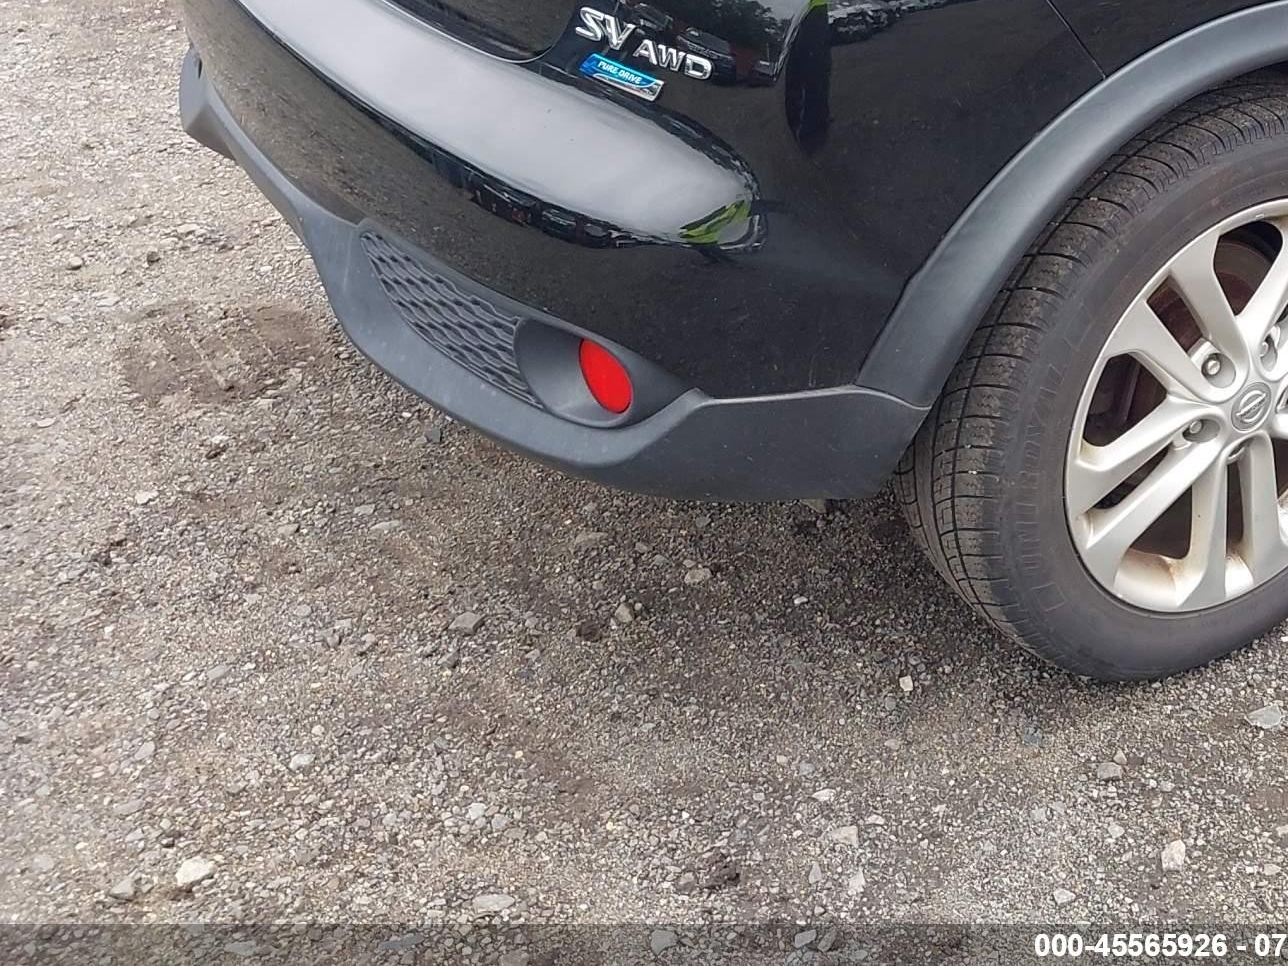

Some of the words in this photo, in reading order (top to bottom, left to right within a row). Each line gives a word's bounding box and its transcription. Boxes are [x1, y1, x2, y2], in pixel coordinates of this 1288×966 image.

[576, 7, 637, 51] SV
[633, 39, 713, 81] AWD
[597, 60, 619, 74] PURE
[618, 69, 643, 85] DRIVE
